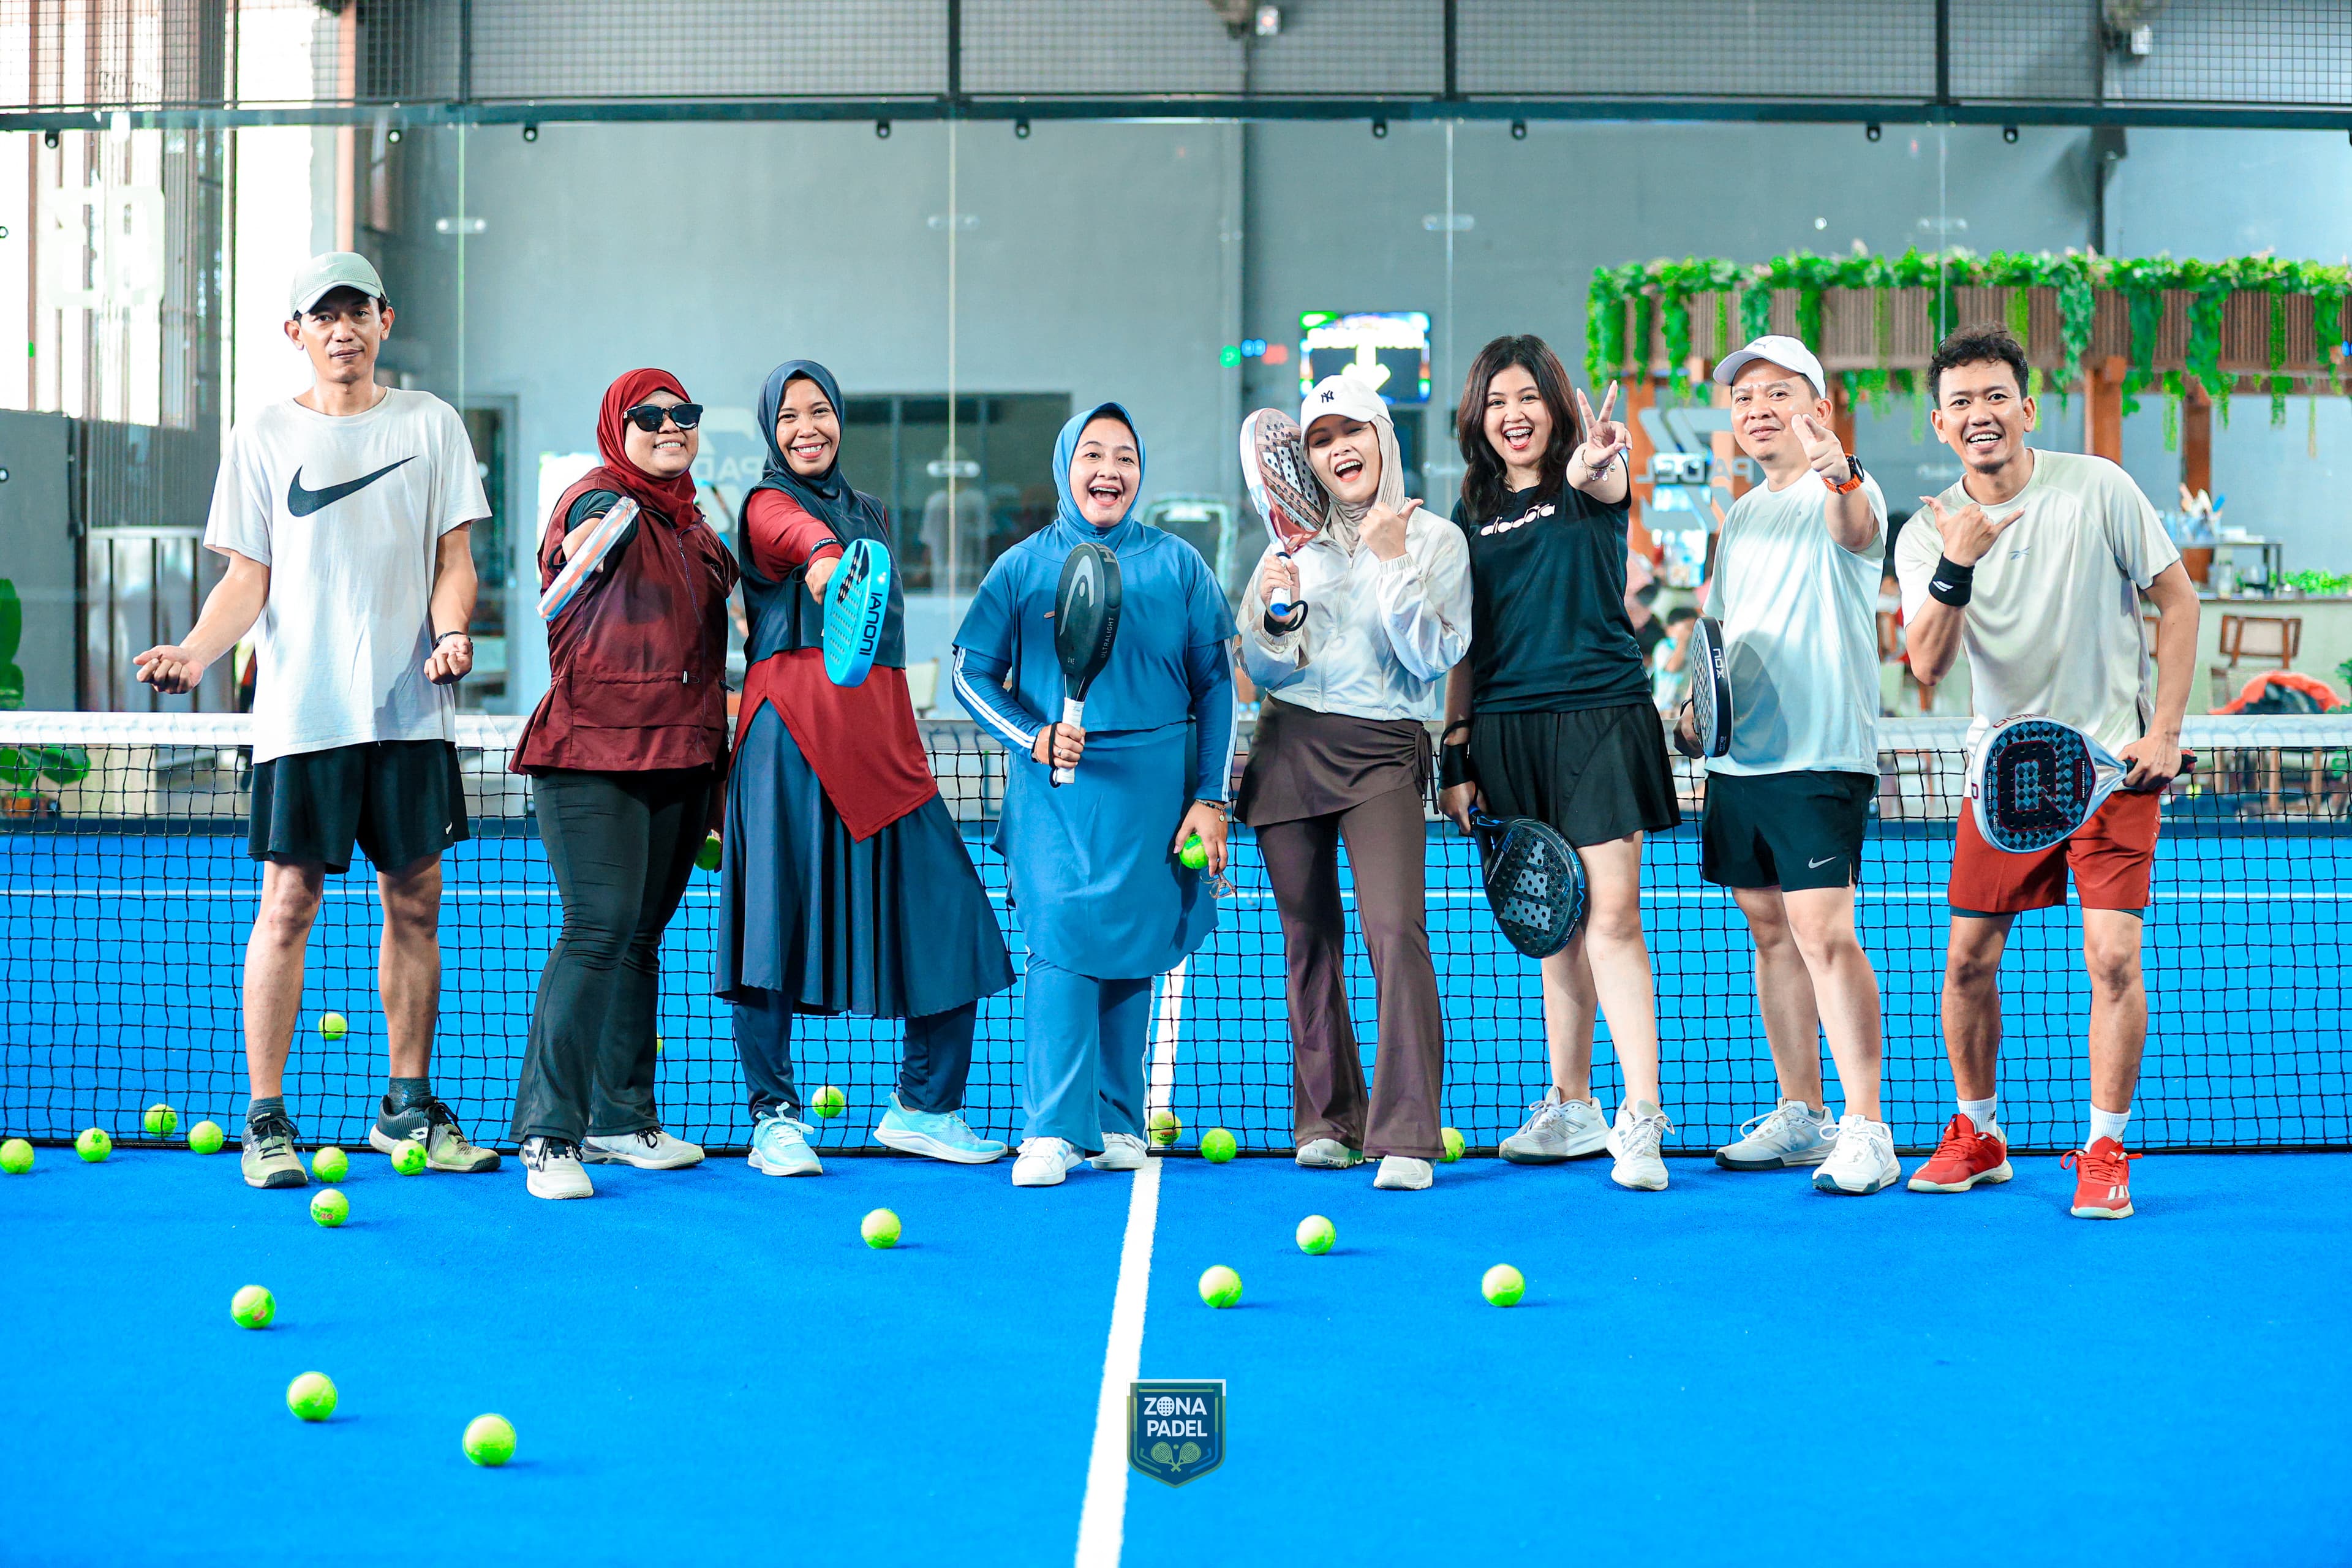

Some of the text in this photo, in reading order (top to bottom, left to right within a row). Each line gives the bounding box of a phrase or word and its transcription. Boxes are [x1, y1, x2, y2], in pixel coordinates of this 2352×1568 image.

[1480, 503, 1555, 536] diadora
[859, 592, 883, 655] IANONI
[1101, 617, 1114, 658] ULTRALIGHT
